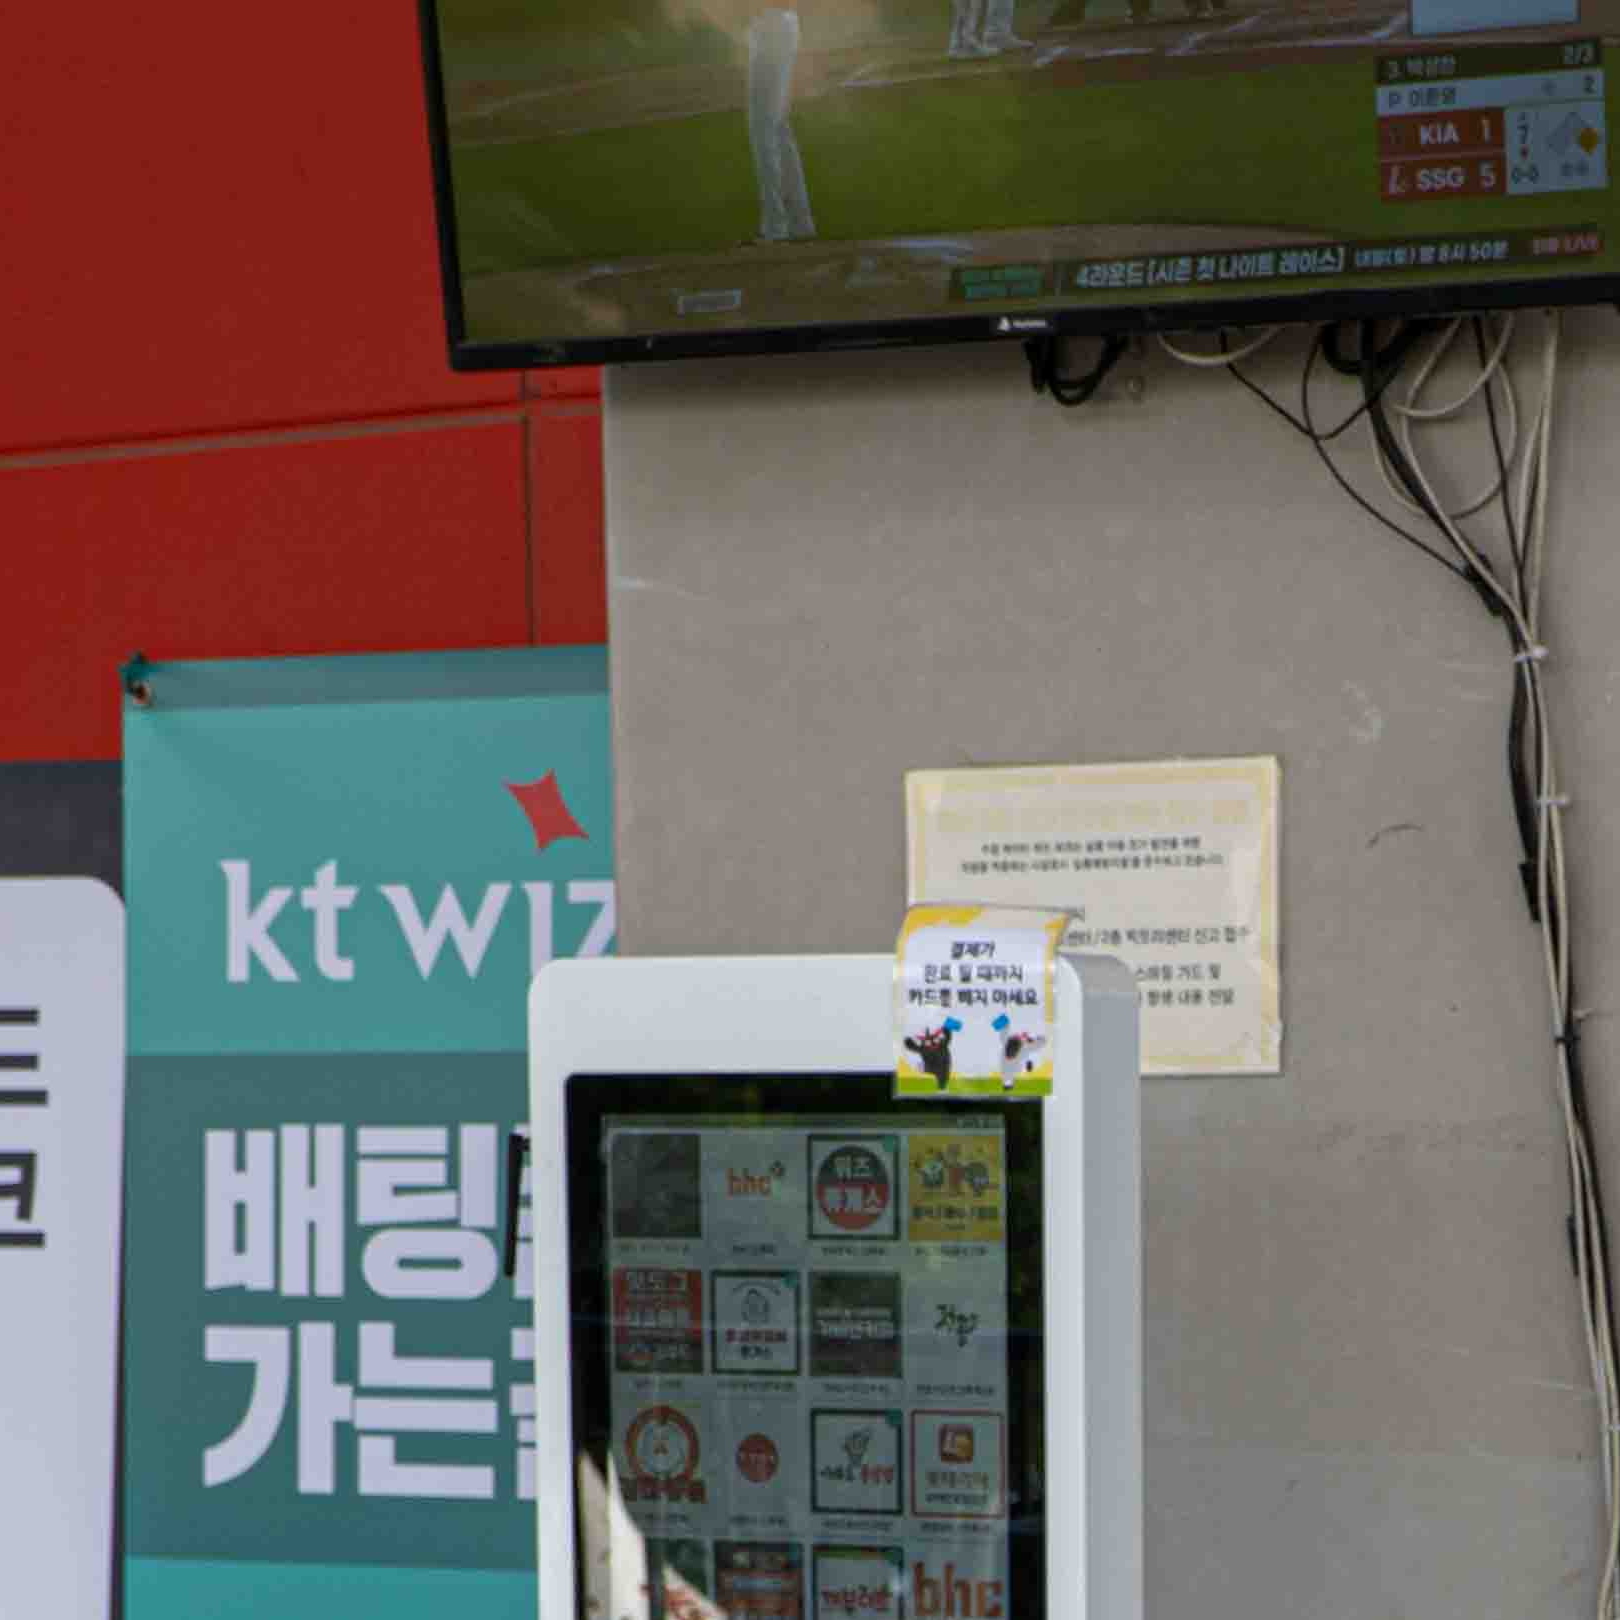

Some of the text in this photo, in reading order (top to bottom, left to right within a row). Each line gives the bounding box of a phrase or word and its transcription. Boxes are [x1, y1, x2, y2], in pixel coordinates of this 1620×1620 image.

[1420, 116, 1491, 144] KIA 1
[1416, 160, 1496, 192] SSG 5
[1077, 260, 1144, 287] 4라운드
[219, 859, 359, 983] kt
[951, 940, 996, 959] 결제가
[908, 988, 952, 1008] 카드를
[992, 987, 1039, 1007] 마세요
[204, 1124, 533, 1300] 배팅
[204, 1322, 536, 1500] 가는
[913, 1560, 1004, 1618] bhc
